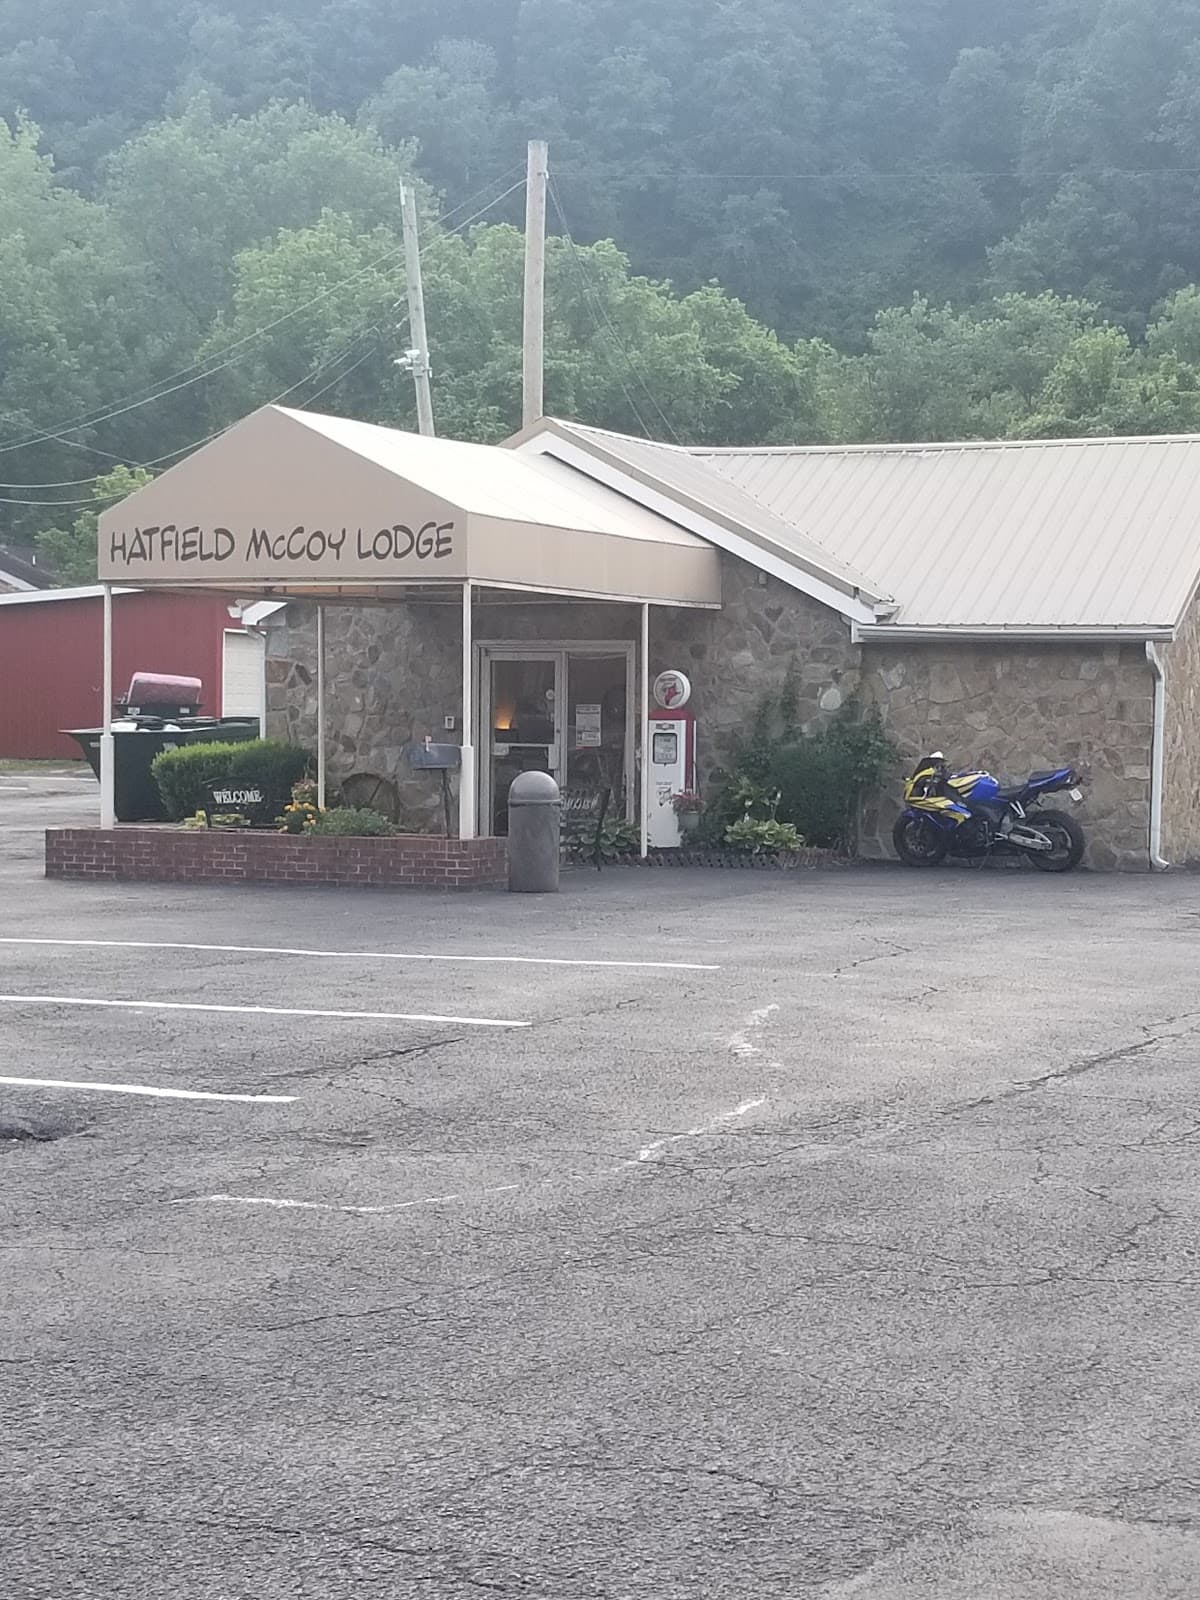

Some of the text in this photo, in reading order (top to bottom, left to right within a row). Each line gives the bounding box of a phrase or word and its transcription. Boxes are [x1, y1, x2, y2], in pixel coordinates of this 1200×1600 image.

[110, 525, 235, 566] HATFIELD
[357, 521, 454, 559] LODGE
[213, 790, 262, 804] WELCOME
